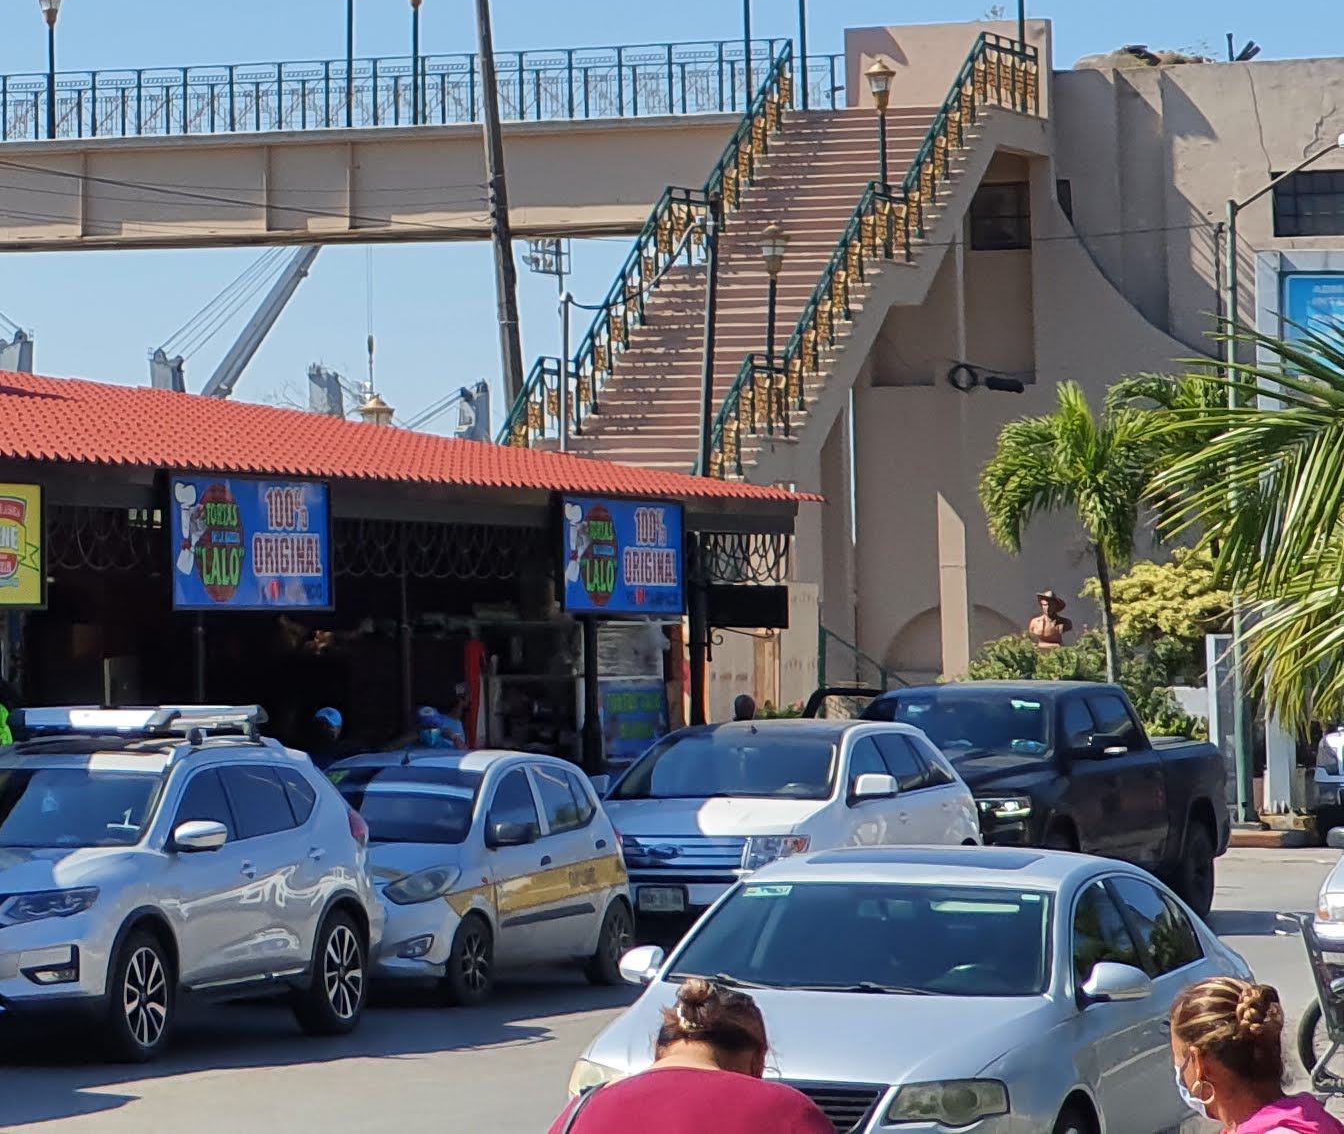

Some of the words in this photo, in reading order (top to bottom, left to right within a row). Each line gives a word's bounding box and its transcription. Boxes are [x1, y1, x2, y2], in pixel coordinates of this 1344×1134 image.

[266, 487, 309, 531] 100%
[634, 507, 668, 546] 100%
[253, 533, 322, 576] ORIGINAL
[624, 546, 677, 586] ORIGINAL
